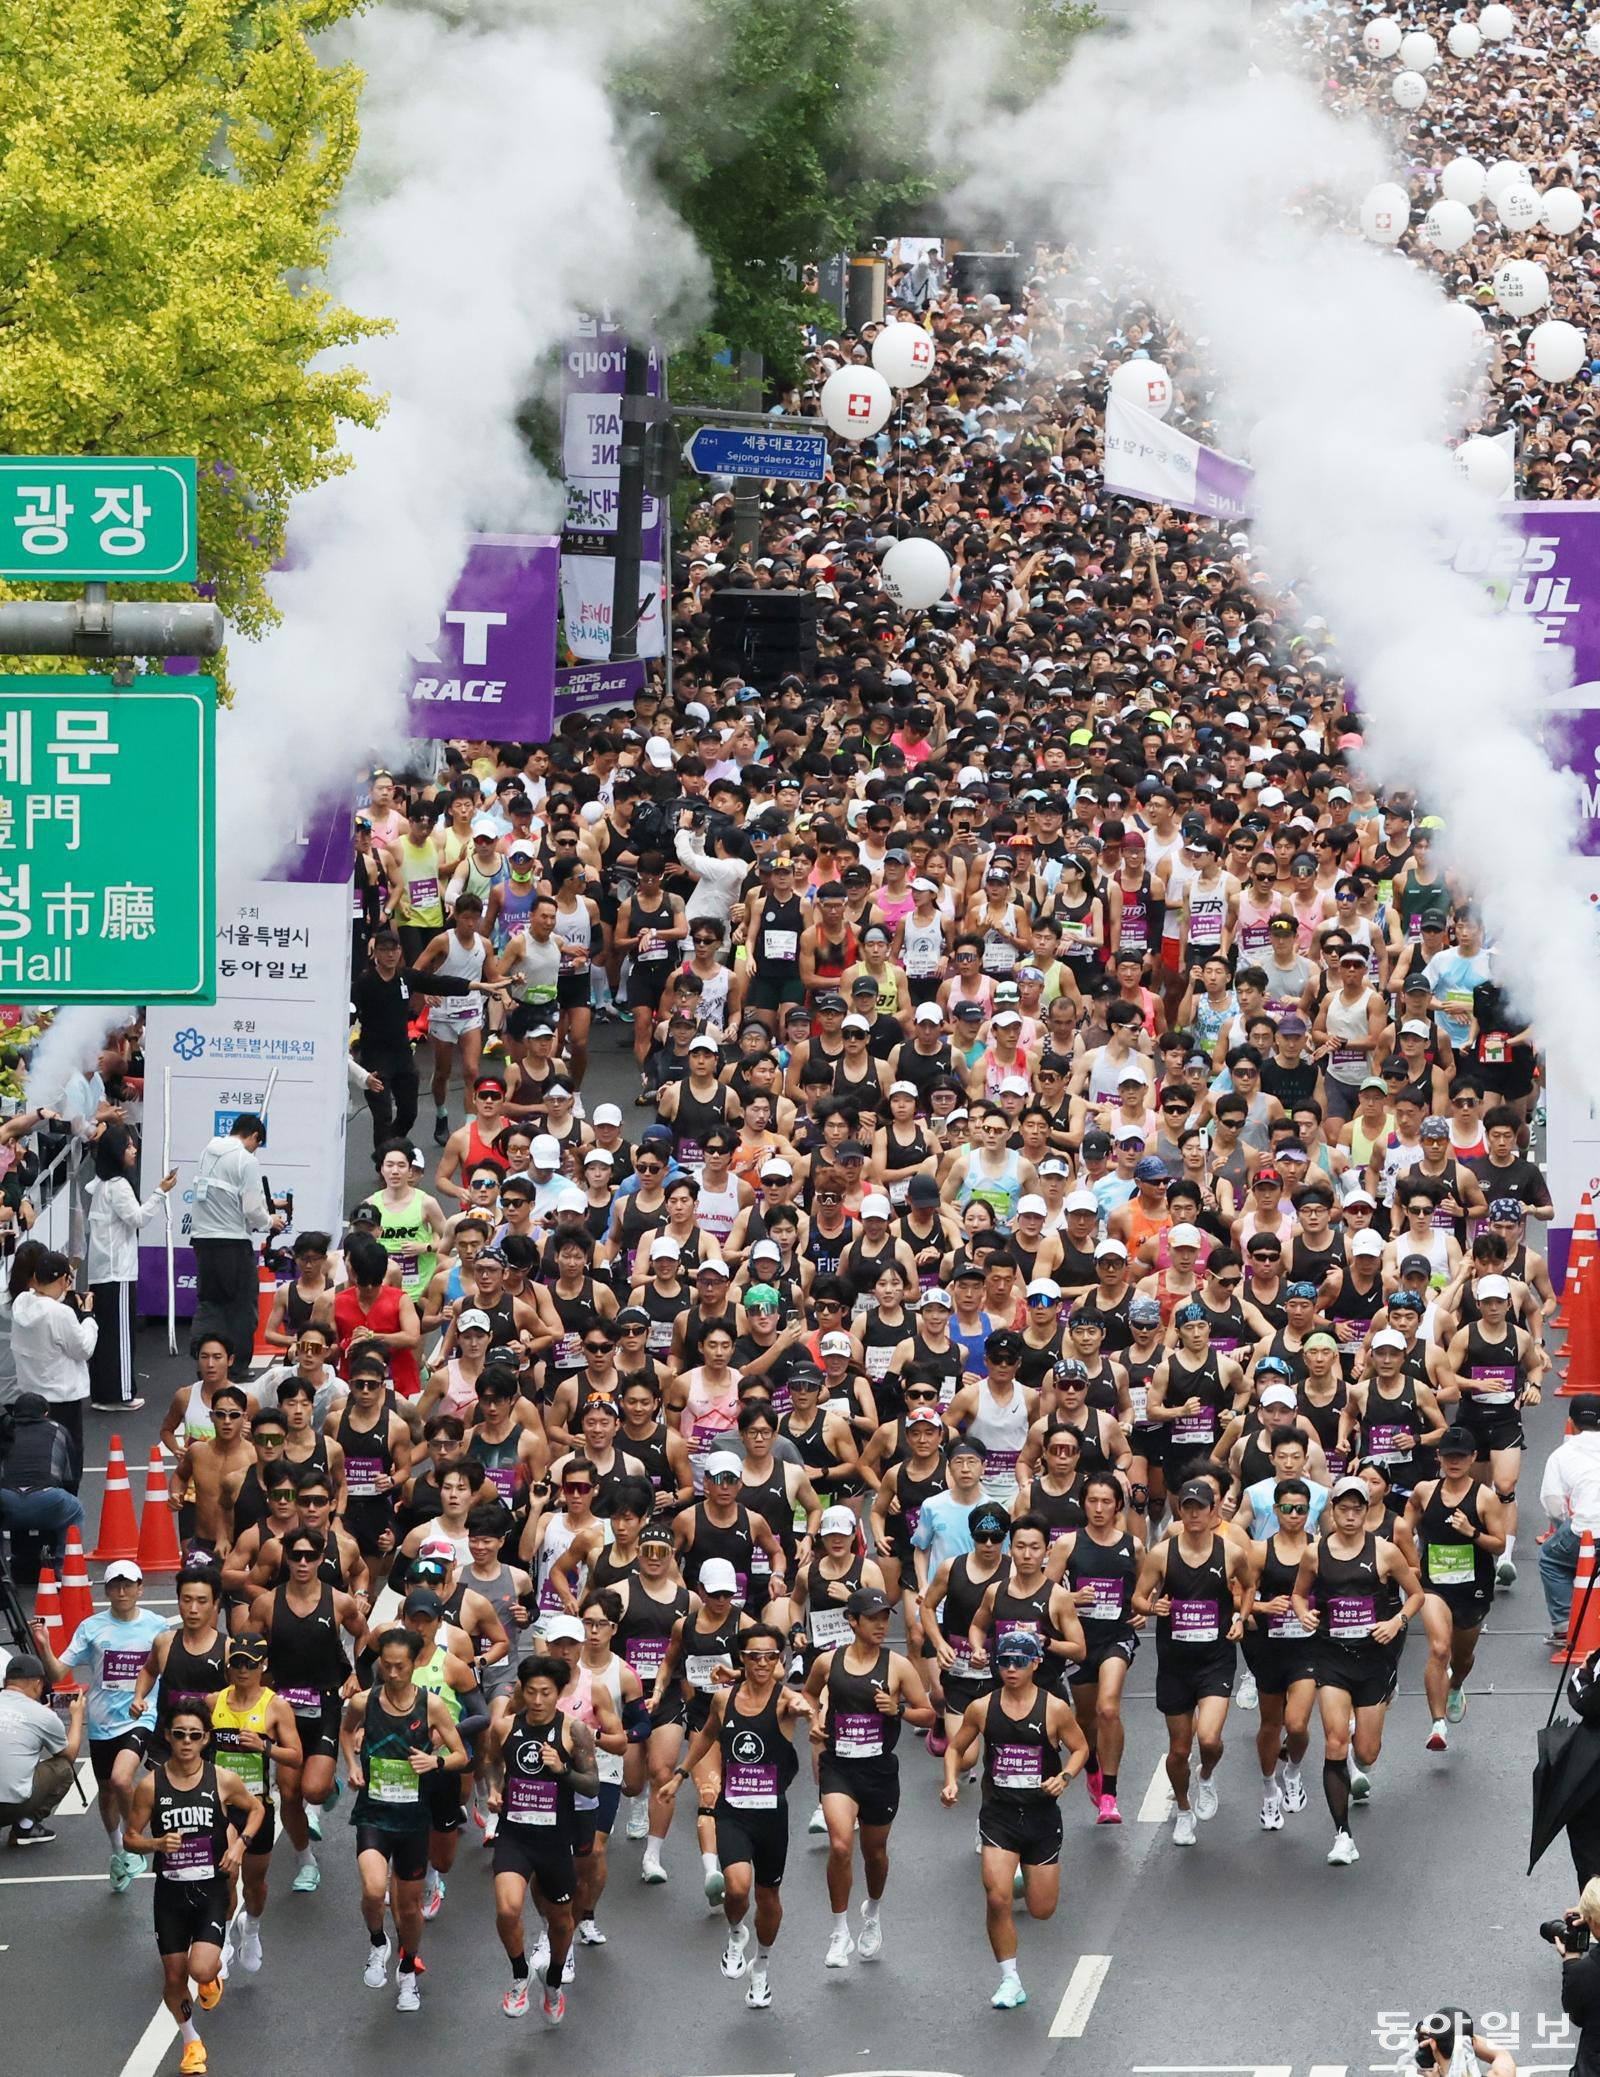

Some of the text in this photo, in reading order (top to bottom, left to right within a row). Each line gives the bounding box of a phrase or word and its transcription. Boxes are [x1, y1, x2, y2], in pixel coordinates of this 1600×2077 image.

[742, 436, 823, 455] 세종대로22길
[727, 451, 821, 468] Sejong-daero 22-gil
[13, 484, 151, 556] 광장
[554, 678, 627, 696] EOUL RACE
[569, 672, 601, 685] 2025
[412, 677, 507, 703] RACE
[42, 882, 155, 941] 市廳
[237, 907, 259, 920] 주최
[216, 924, 309, 948] 서울특별시
[0, 947, 71, 982] Hall
[218, 959, 309, 979] 동아일보
[233, 1020, 255, 1032] 후원
[209, 1036, 315, 1055] 서울특별시체육회
[219, 1092, 265, 1105] 공식음료
[161, 1806, 214, 1830] STONE
